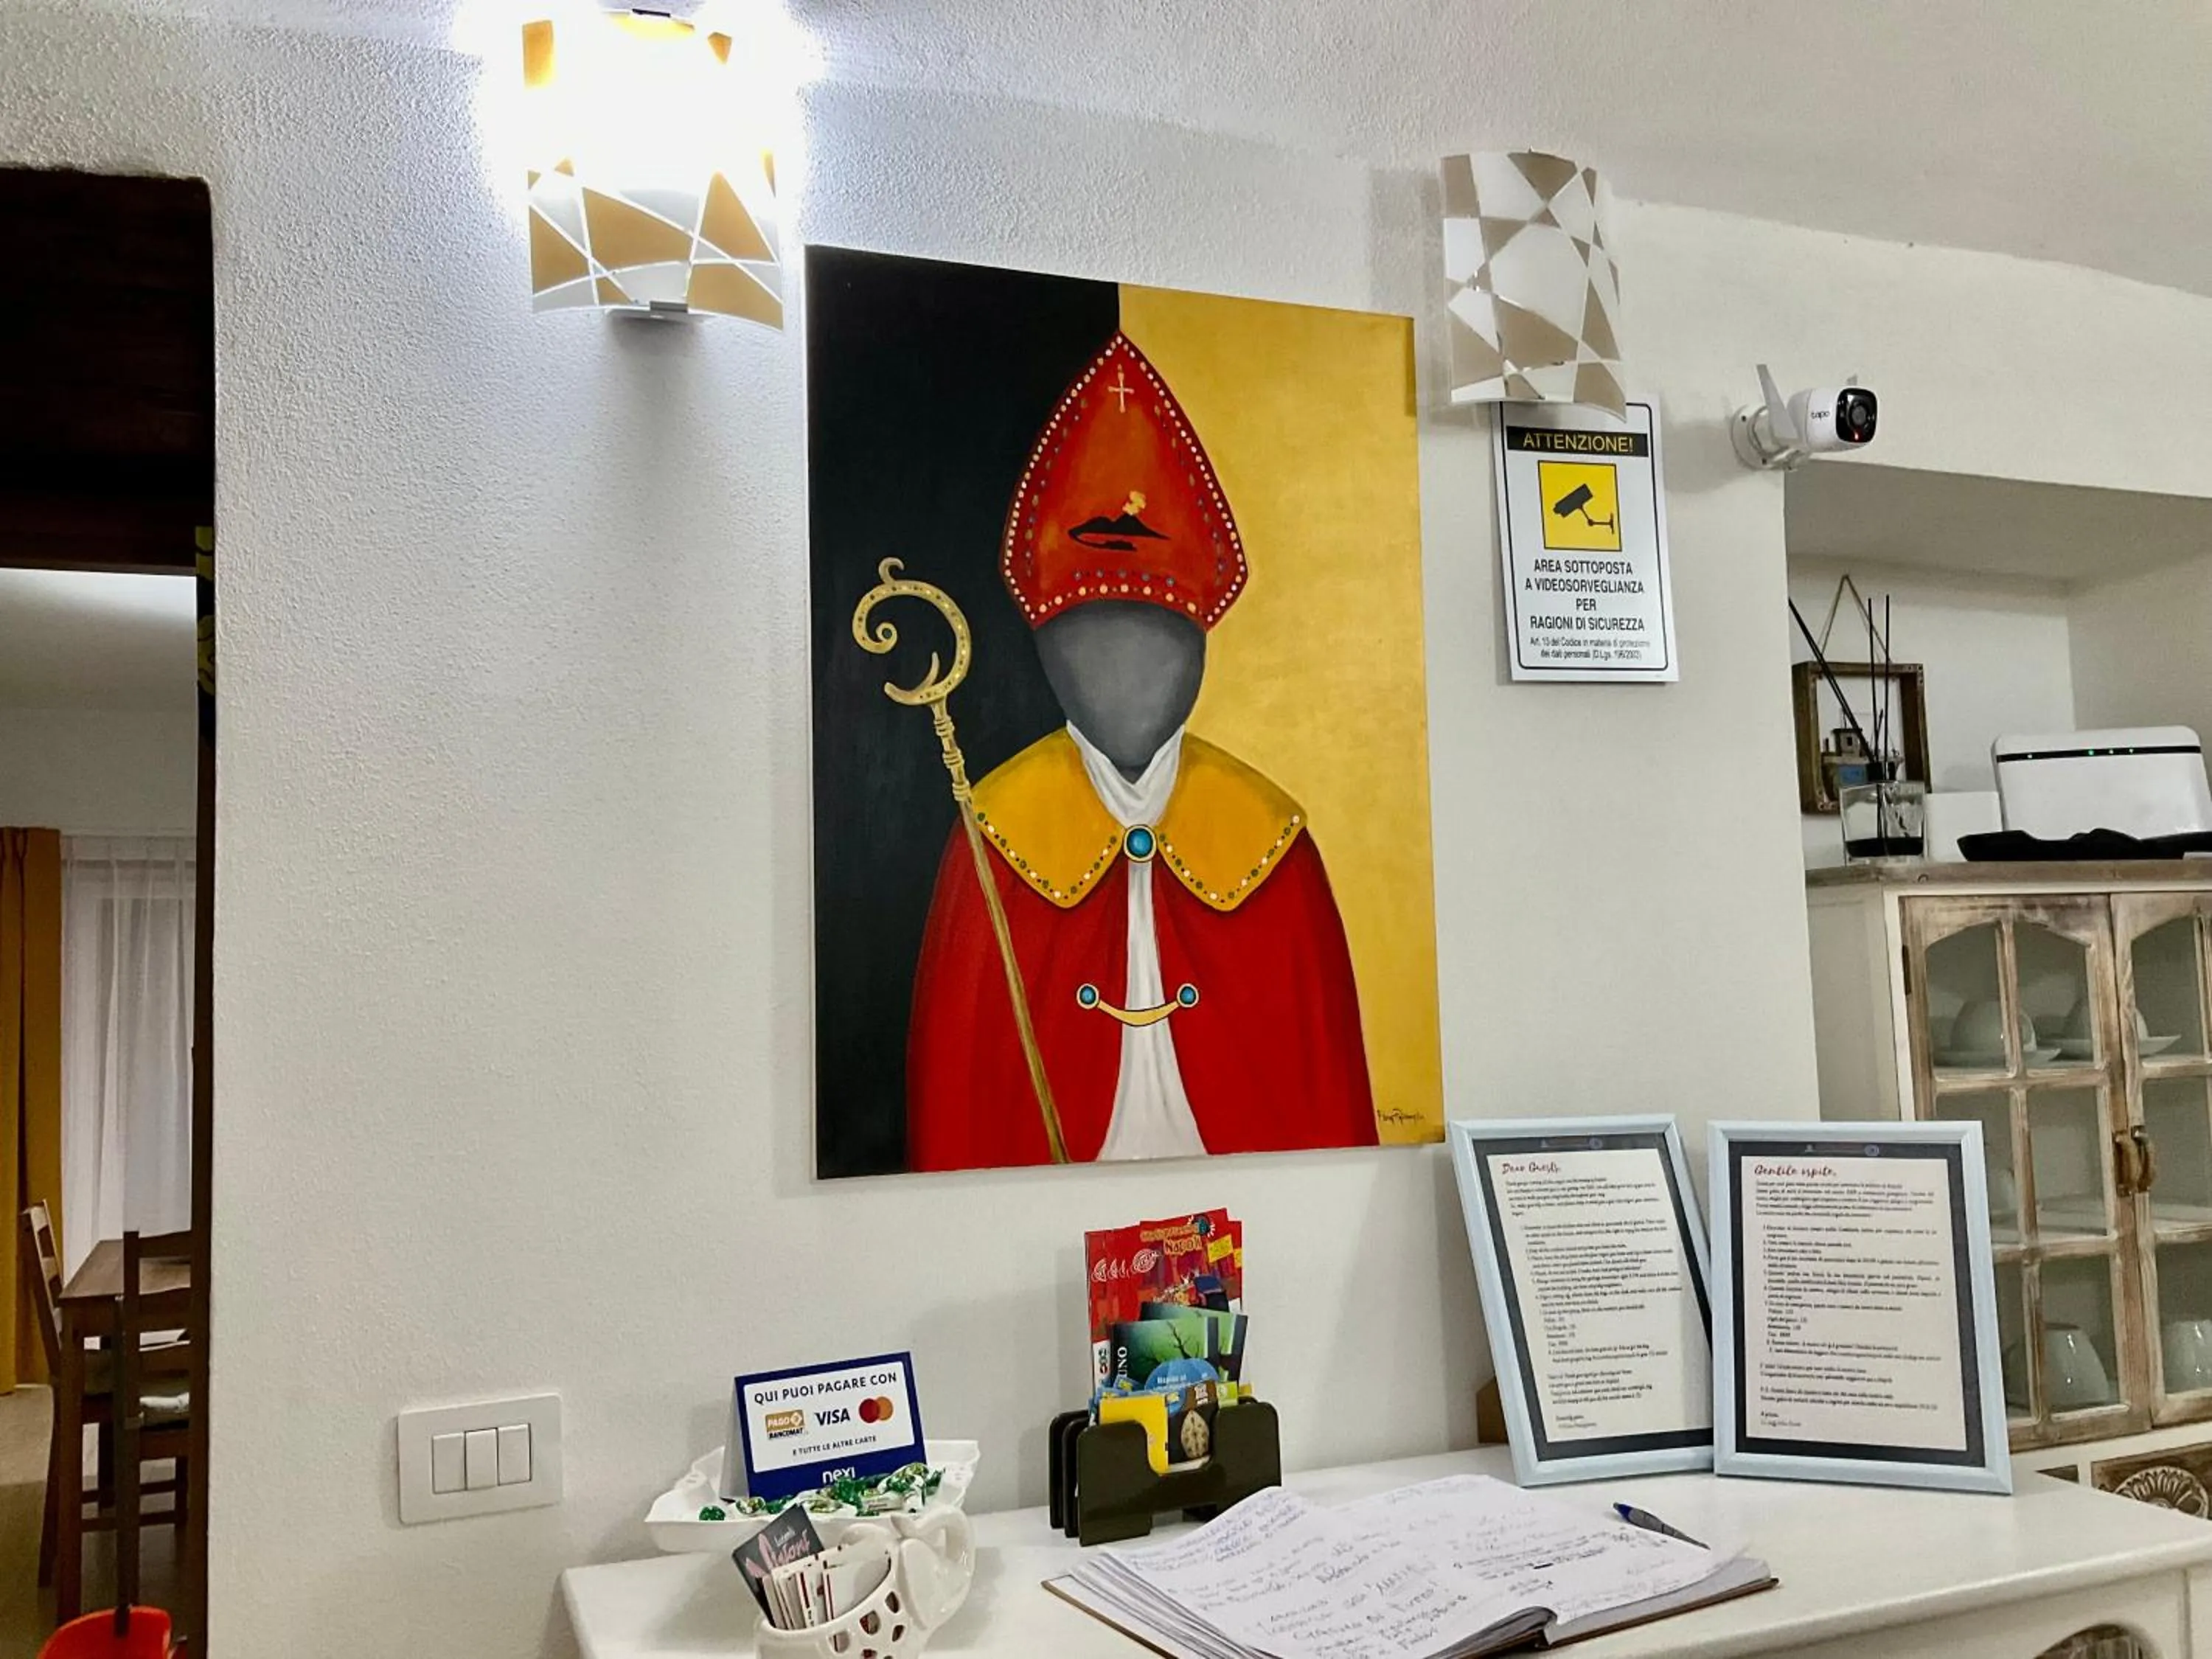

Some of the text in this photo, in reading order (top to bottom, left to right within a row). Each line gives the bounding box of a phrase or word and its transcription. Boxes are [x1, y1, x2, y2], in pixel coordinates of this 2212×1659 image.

[1810, 410, 1830, 421] tapo
[1522, 432, 1634, 453] ATTENZIONE!
[1534, 559, 1633, 574] AREA SOTTOPOSTA
[1525, 578, 1645, 594] A VIDEOSORVEGLIANZA
[1576, 598, 1597, 611] PER
[1530, 616, 1646, 631] RAGIONI DI SICUREZZA
[1561, 636, 1582, 647] Codice
[1501, 1163, 1526, 1175] Dear
[1754, 1164, 1797, 1176] Gentile
[754, 1372, 897, 1405] QUI PUOI PAGARE CON
[815, 1408, 851, 1426] VISA
[768, 1427, 804, 1439] BANCOMAT
[799, 1445, 821, 1455] TUTTE
[822, 1443, 830, 1451] LE
[832, 1439, 853, 1450] ALTRE
[855, 1436, 877, 1445] CARTE
[822, 1467, 856, 1484] nexi
